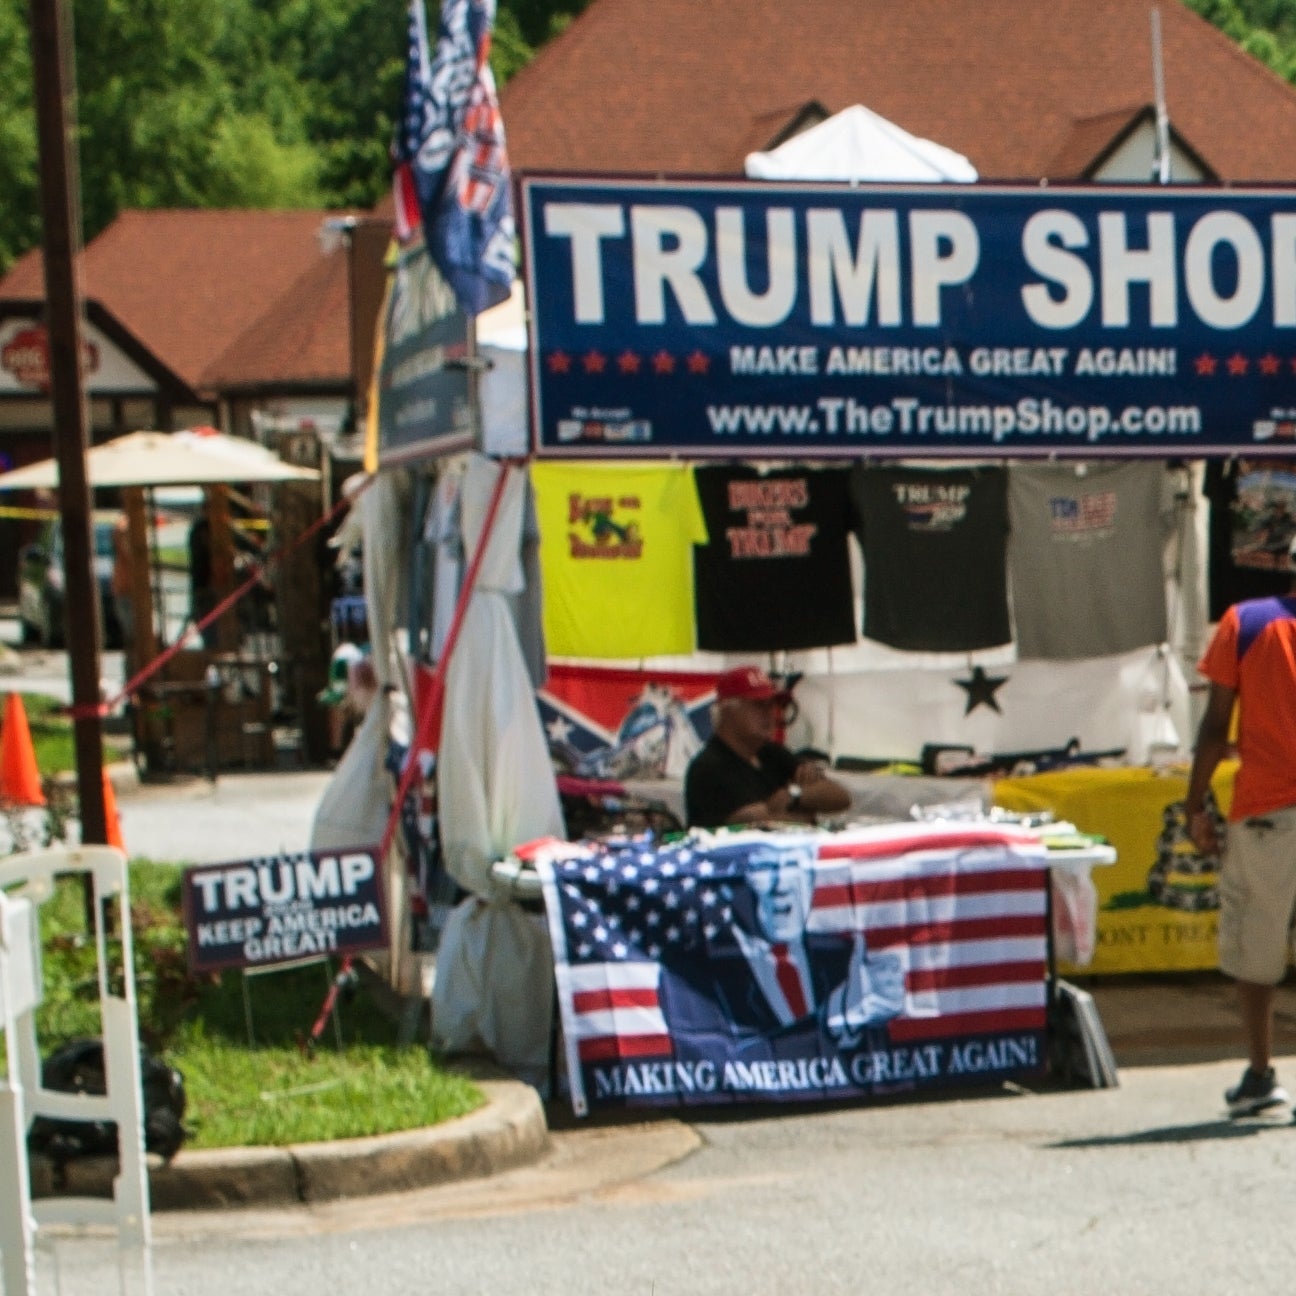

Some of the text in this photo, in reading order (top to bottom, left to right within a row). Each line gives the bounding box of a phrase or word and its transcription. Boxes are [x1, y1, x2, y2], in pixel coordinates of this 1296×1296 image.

[546, 204, 980, 327] TRUMP
[729, 346, 1177, 377] MAKE AMERICA GREAT AGAIN!
[706, 397, 1202, 442] www.TheTrumpShop.com
[892, 483, 970, 504] TRUMP
[192, 853, 375, 912] TRUMP
[197, 902, 381, 947] KEEP AMERICA
[244, 931, 337, 961] GREAT!
[593, 1036, 1038, 1098] MAKING AMERICA GREAT AGAIN!
